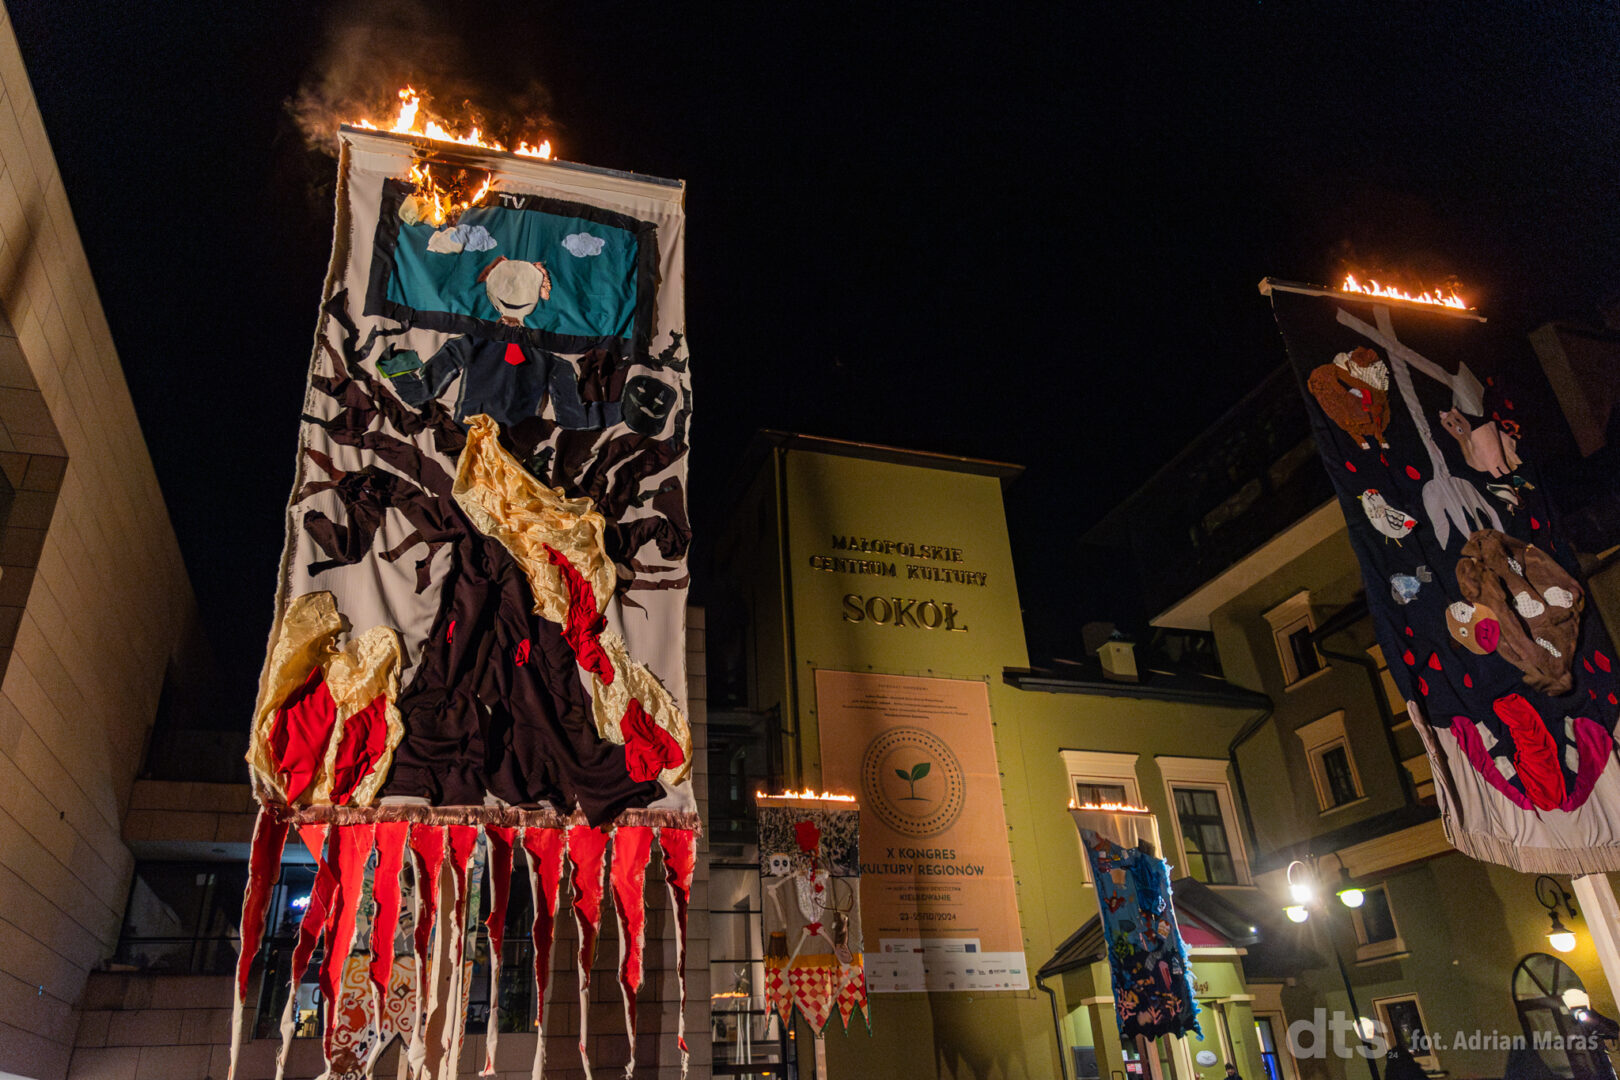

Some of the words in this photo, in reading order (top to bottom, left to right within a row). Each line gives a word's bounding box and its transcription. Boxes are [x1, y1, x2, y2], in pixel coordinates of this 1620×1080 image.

[498, 193, 526, 210] TV
[832, 535, 963, 563] MAŁOPOLSKIE
[809, 554, 897, 577] CENTRUM
[906, 564, 988, 587] KULTURY
[842, 593, 969, 633] SOKÓŁ
[886, 847, 895, 859] X
[898, 847, 957, 860] KONGRES
[918, 863, 985, 876] REGIONÓW
